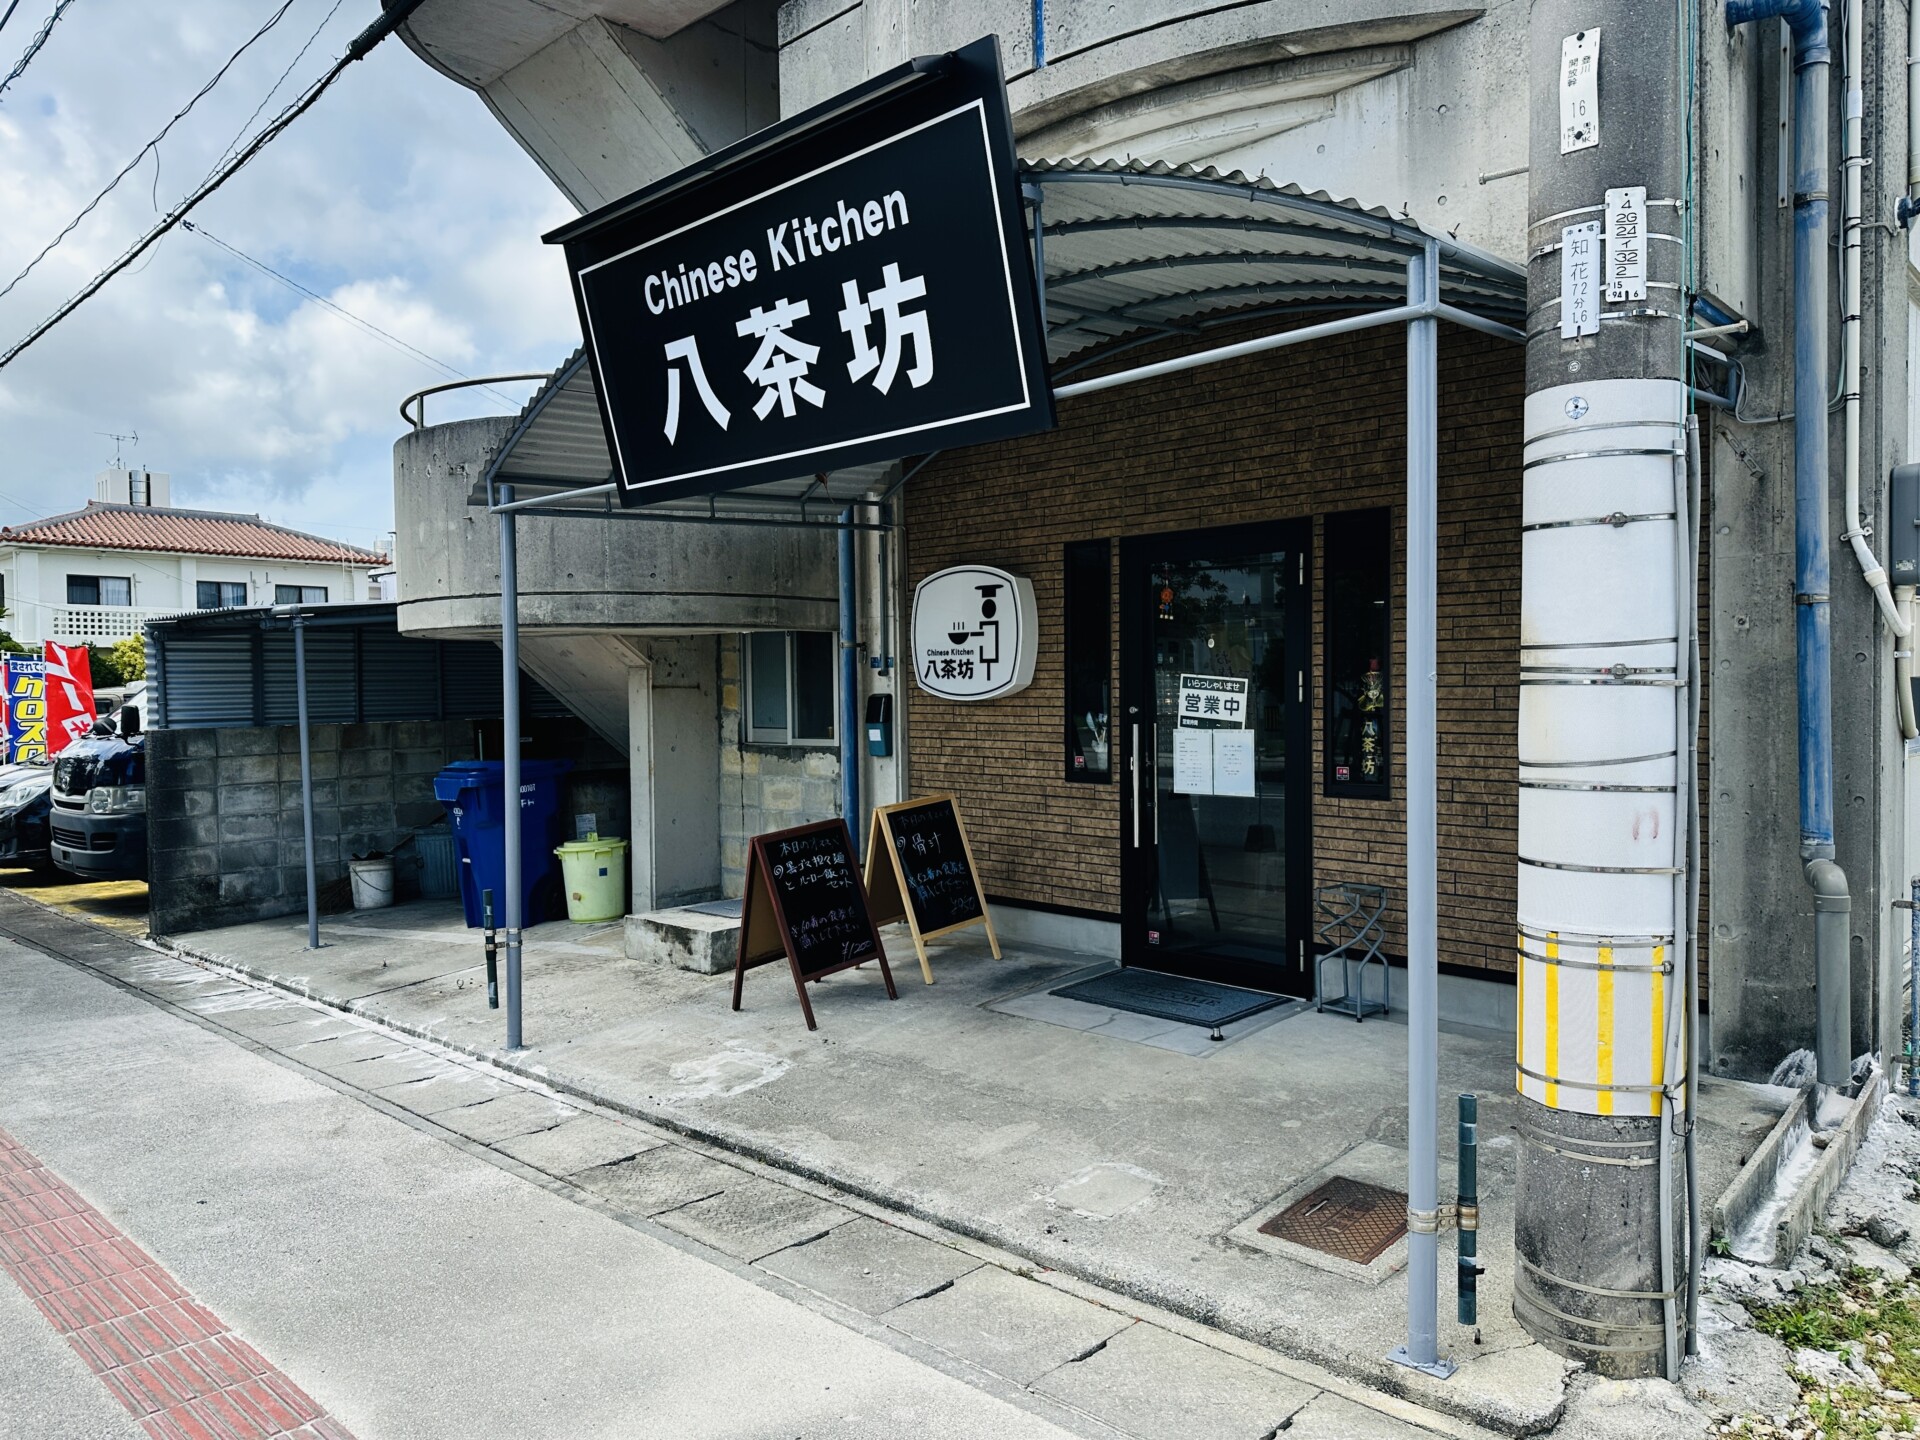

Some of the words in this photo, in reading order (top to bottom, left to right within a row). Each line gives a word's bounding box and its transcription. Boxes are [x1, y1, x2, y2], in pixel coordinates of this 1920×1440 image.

[1572, 99, 1586, 118] 16
[1620, 200, 1633, 209] 4
[1615, 212, 1638, 223] 2G
[1616, 225, 1637, 236] 24
[644, 249, 758, 315] Chinese
[766, 190, 910, 272] Kitchen
[1614, 252, 1638, 263] 32
[1616, 266, 1627, 276] 2
[1613, 281, 1623, 289] 15
[1633, 290, 1639, 298] 6
[663, 261, 934, 446] 八茶坊
[926, 648, 950, 657] Chinese
[950, 648, 974, 656] Kitchen
[924, 658, 974, 680] 八茶坊
[1187, 679, 1241, 692] いらっしゃいませ
[1185, 692, 1240, 717] 営業中
[1361, 721, 1376, 775] 八茶坊
